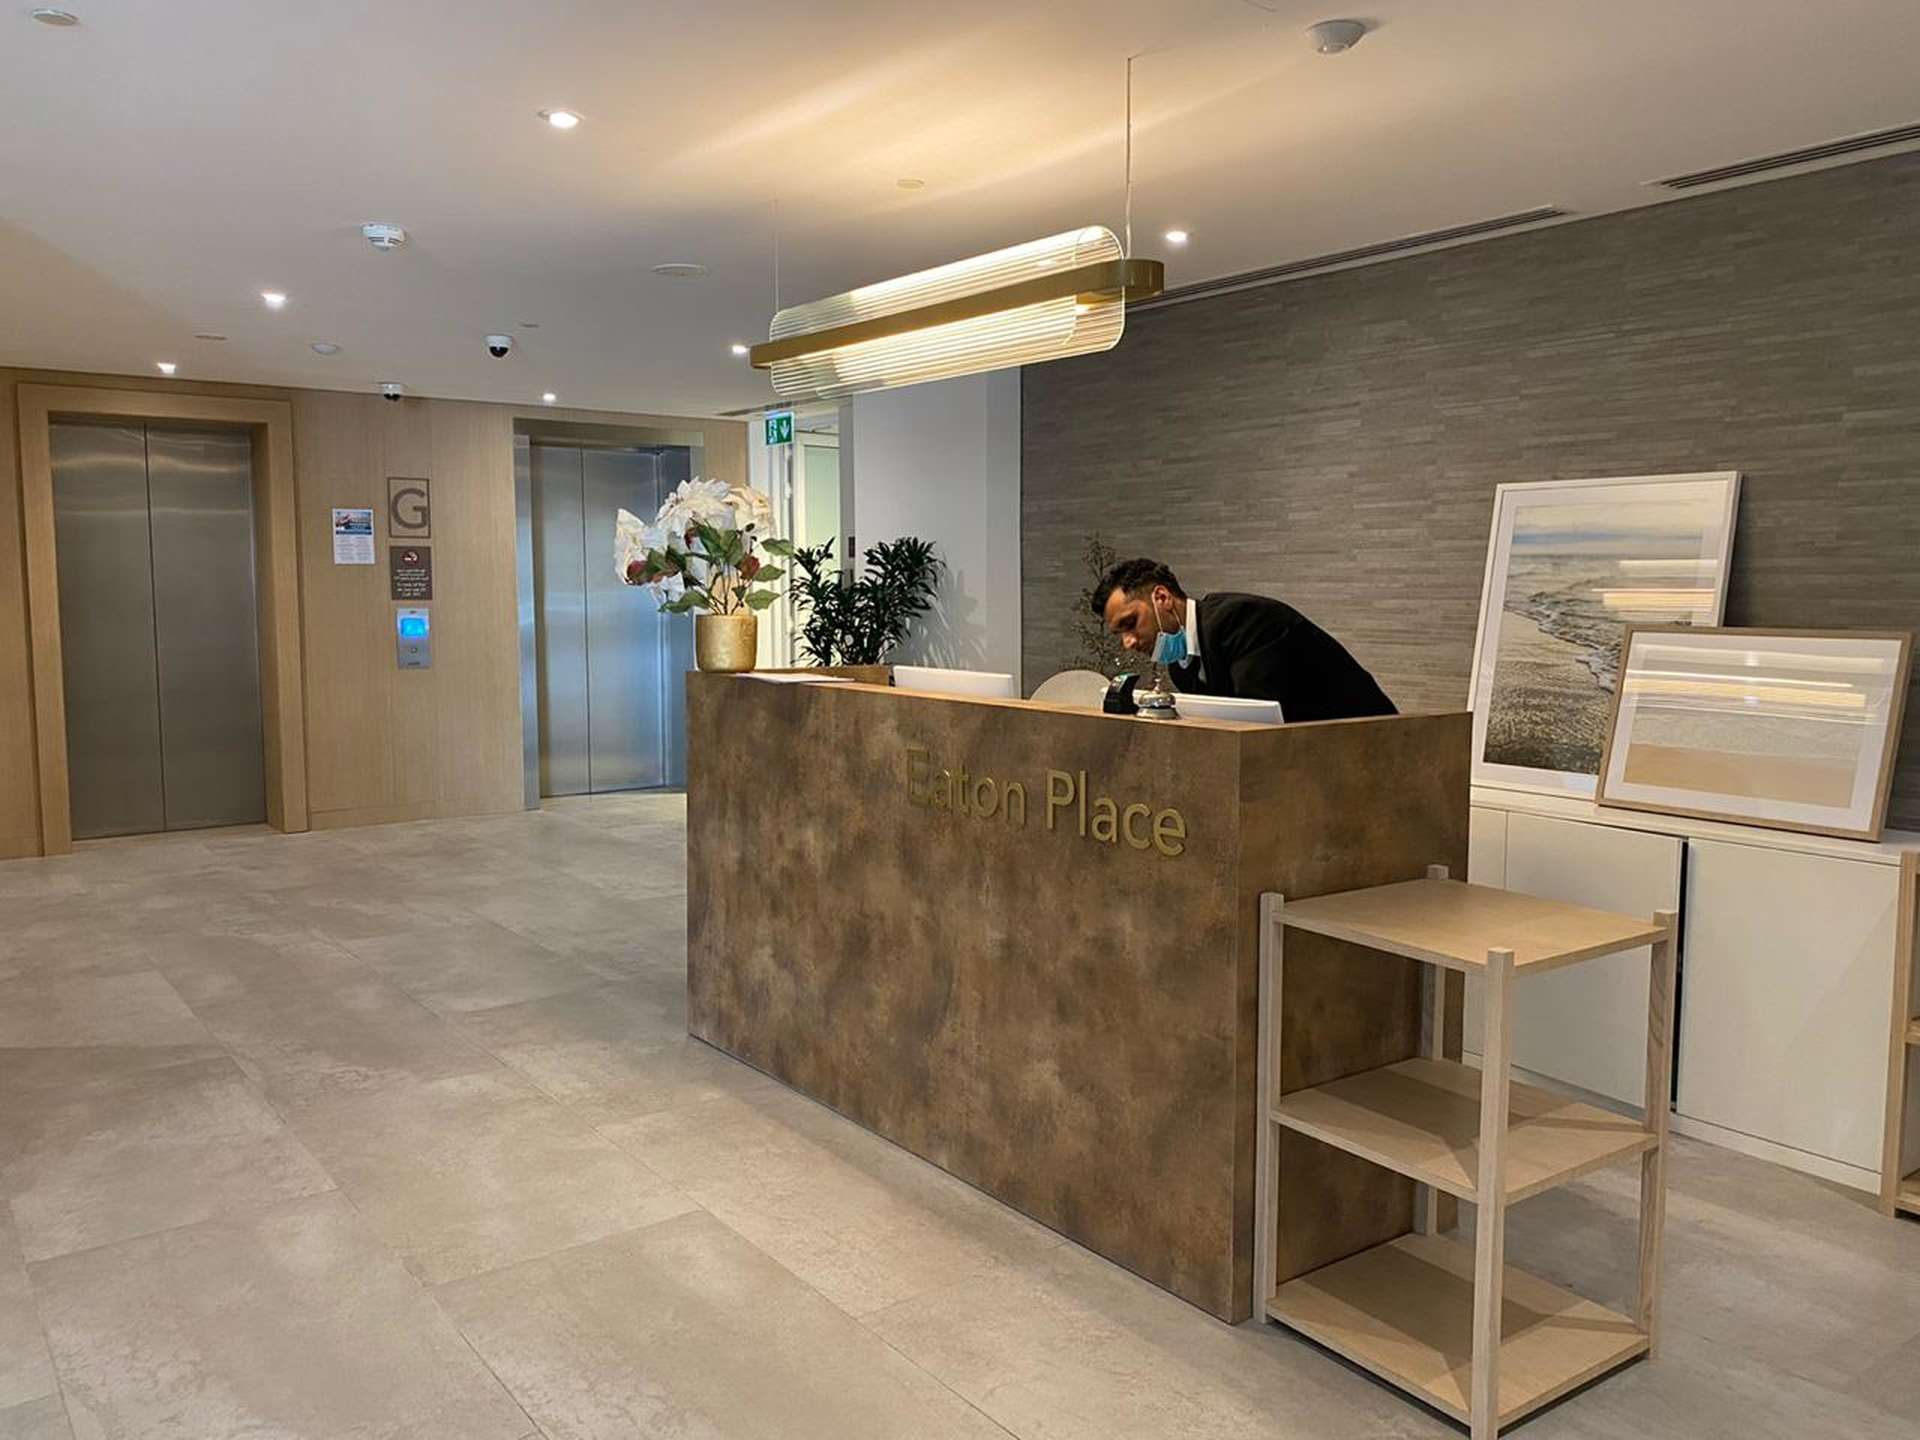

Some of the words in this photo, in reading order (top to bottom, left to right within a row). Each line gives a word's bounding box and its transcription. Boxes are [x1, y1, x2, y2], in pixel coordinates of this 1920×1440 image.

[392, 488, 427, 529] G
[907, 749, 1027, 831] Eaton
[1047, 768, 1187, 856] Place
